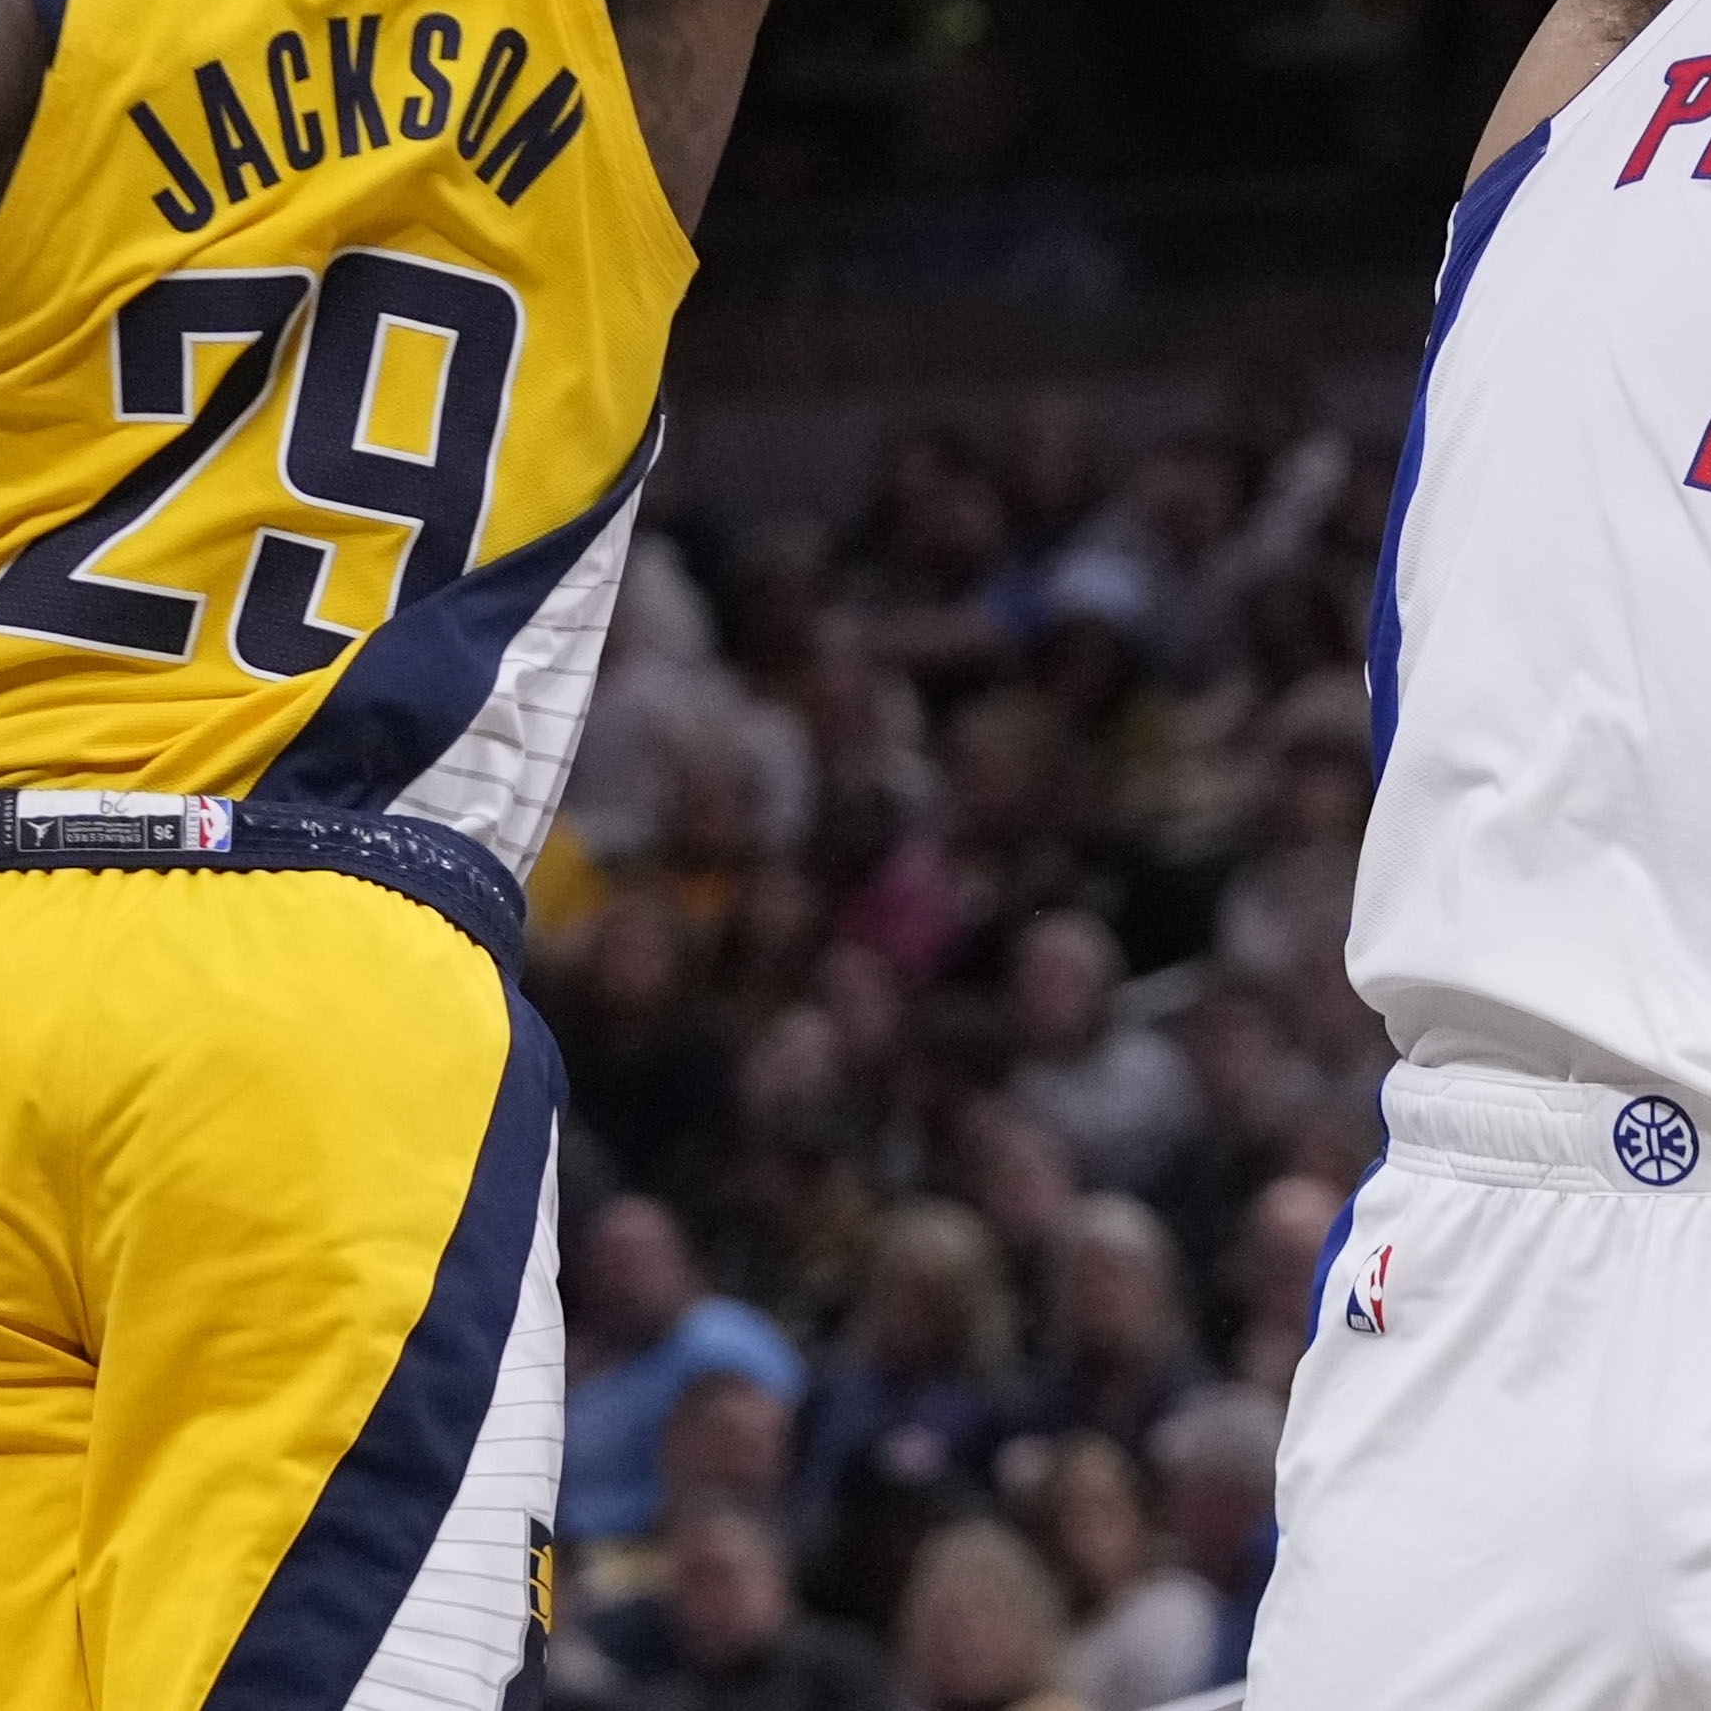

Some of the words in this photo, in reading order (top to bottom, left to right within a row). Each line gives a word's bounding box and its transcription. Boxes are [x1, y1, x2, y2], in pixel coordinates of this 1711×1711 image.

[127, 11, 586, 234] JACKSON
[152, 823, 175, 841] 36
[1618, 1113, 1694, 1170] 313
